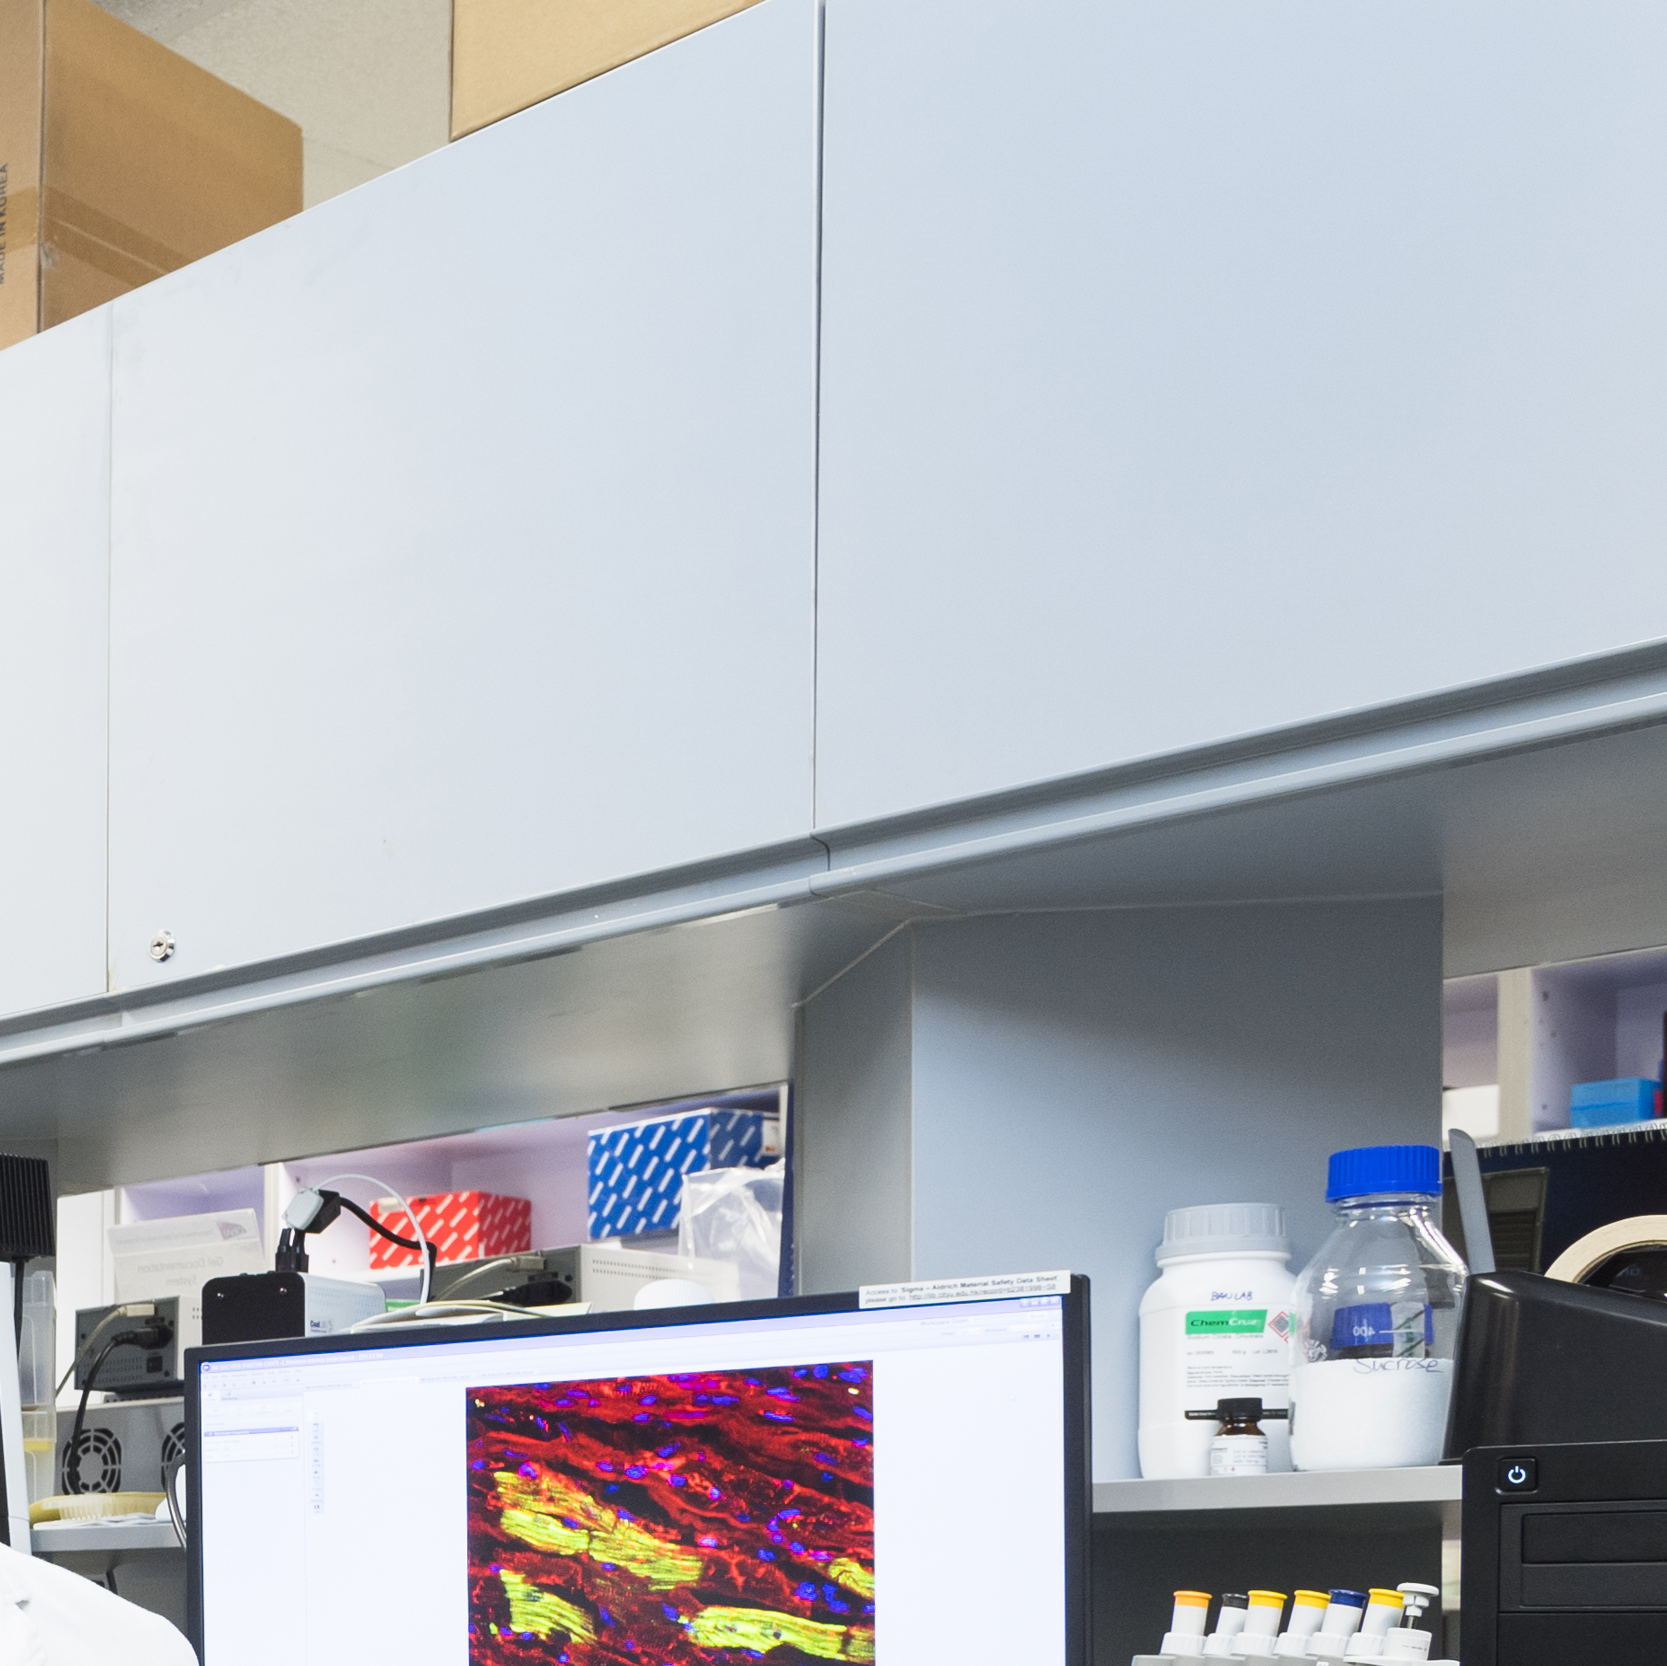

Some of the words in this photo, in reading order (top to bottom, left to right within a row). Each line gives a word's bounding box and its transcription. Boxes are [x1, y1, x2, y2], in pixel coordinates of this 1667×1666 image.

[901, 1286, 924, 1294] Sigma
[960, 1280, 989, 1288] Material
[991, 1278, 1014, 1286] Safety
[1234, 1290, 1253, 1300] LAB
[1190, 1317, 1258, 1327] ChemCruz
[1353, 1358, 1444, 1374] Sucrose
